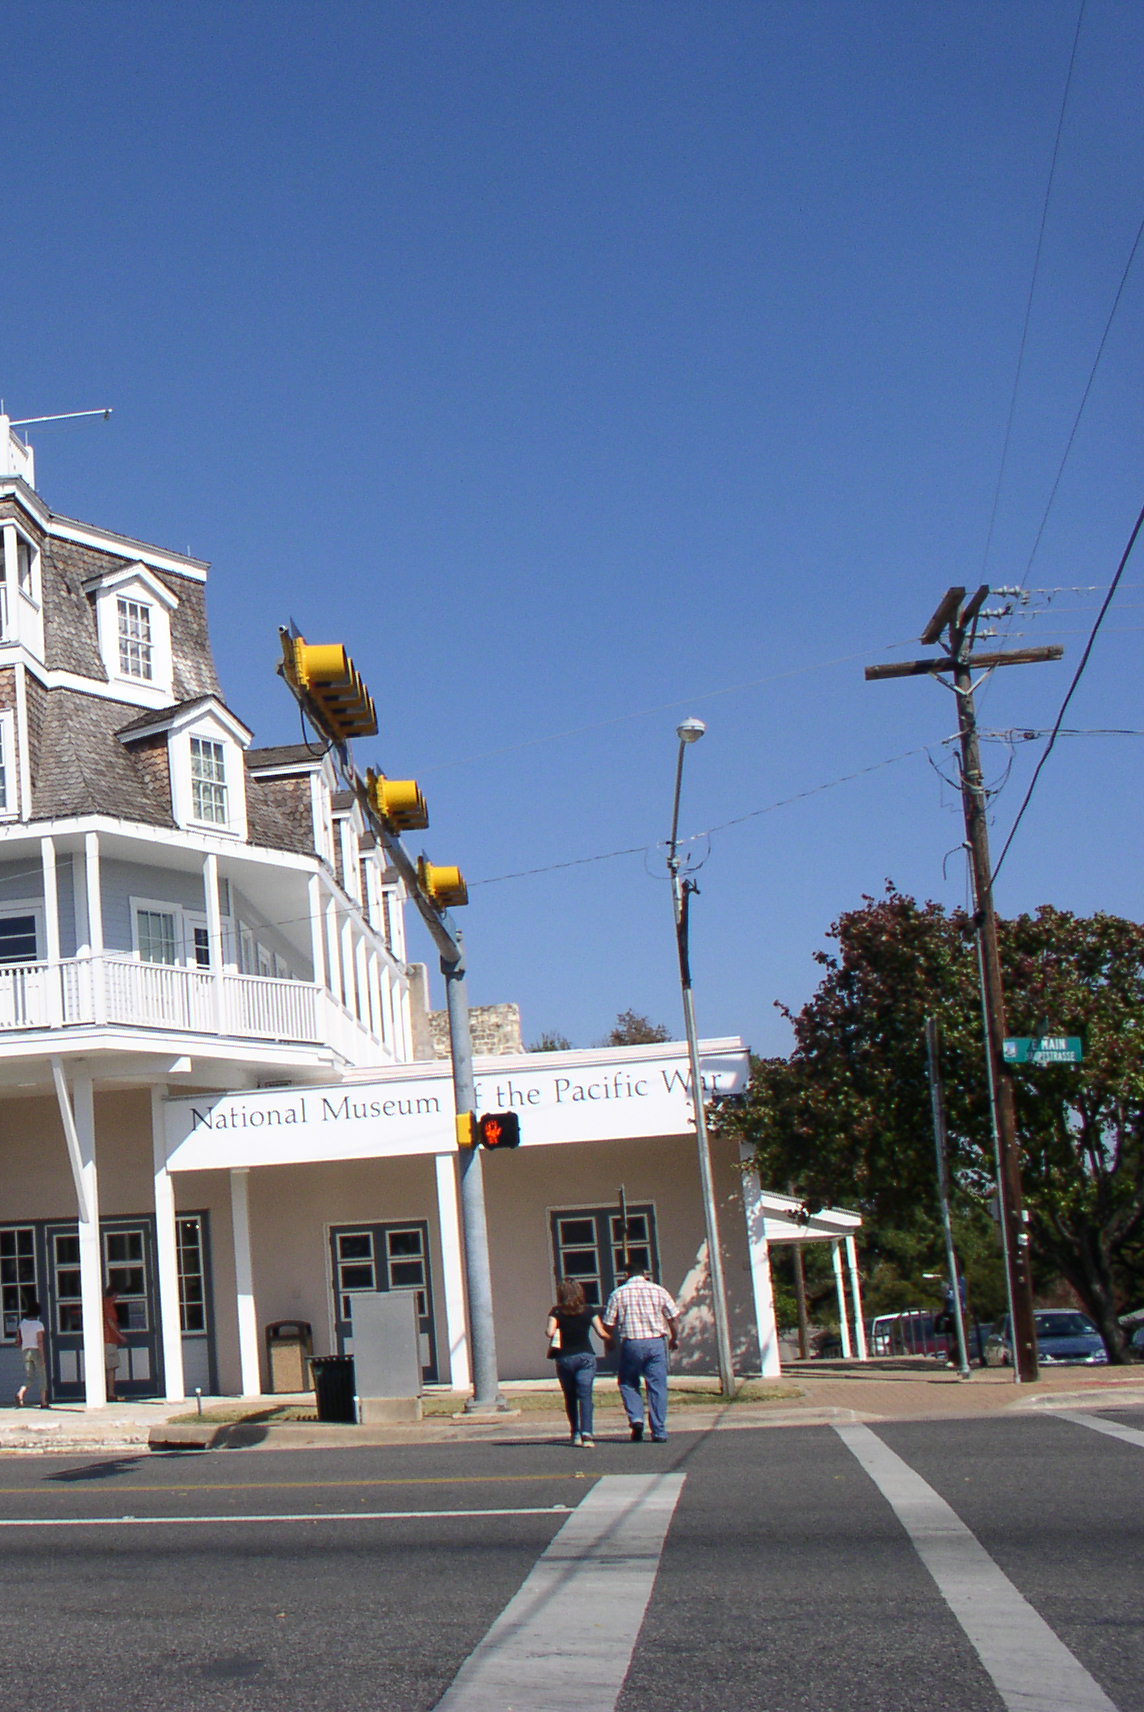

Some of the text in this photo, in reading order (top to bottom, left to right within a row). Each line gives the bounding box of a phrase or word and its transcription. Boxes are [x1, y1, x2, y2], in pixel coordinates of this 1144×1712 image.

[1040, 1038, 1067, 1051] MAIN
[191, 1098, 307, 1131] National
[321, 1096, 442, 1121] Museum
[496, 1080, 540, 1108] the
[554, 1071, 649, 1104] Pacific
